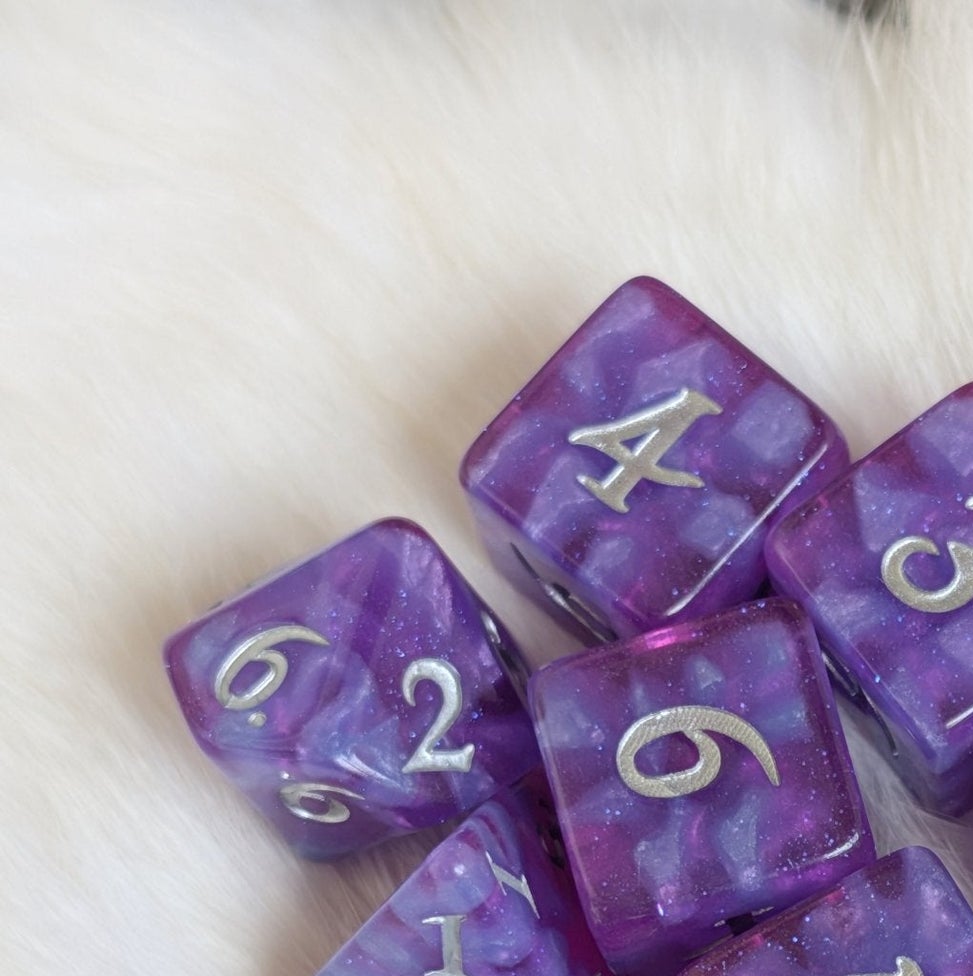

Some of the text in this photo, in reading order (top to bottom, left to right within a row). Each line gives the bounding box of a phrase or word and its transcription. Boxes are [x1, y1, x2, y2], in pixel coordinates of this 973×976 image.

[568, 387, 723, 515] 4
[402, 658, 475, 773] 2
[616, 705, 781, 798] 6
